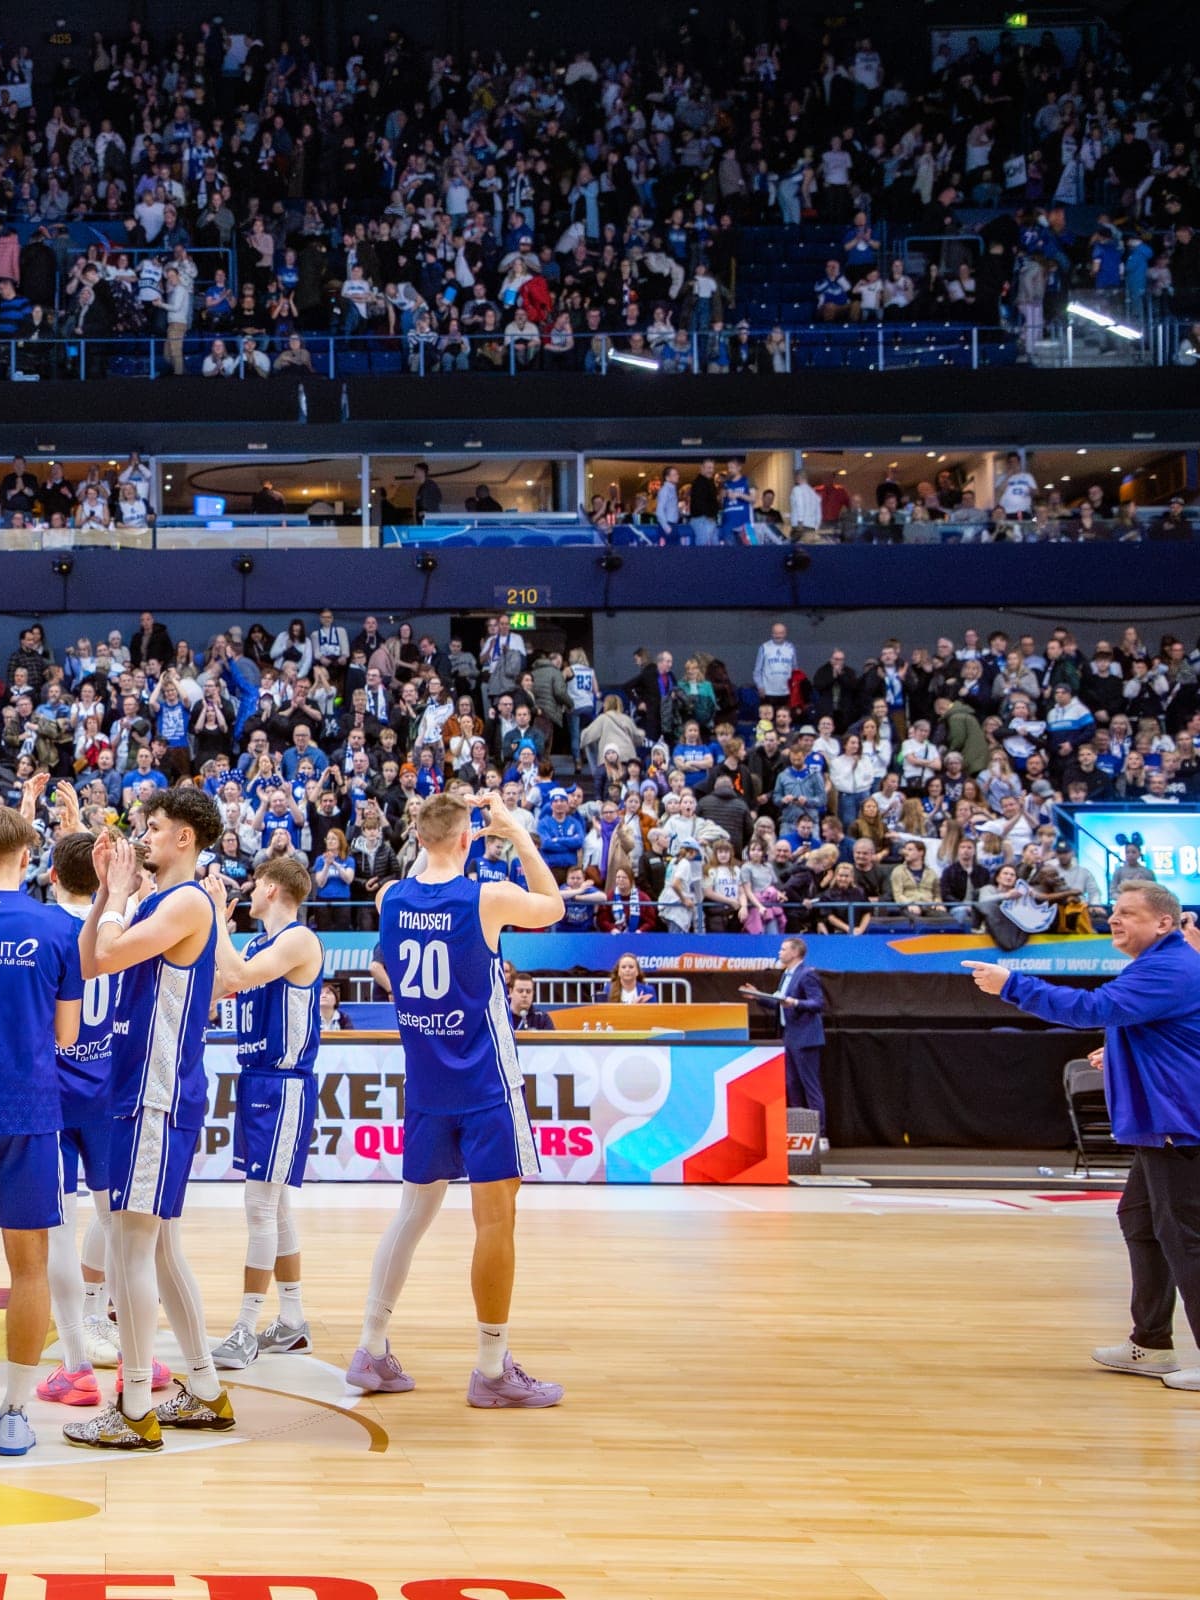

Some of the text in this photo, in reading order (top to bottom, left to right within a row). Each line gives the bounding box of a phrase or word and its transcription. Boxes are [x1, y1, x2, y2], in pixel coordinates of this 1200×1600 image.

[507, 588, 538, 604] 210
[399, 910, 452, 932] MADSEN
[3, 956, 15, 966] full
[15, 958, 36, 967] circle
[694, 957, 725, 969] WOLF
[727, 957, 777, 970] COUNTRY
[399, 939, 450, 1000] 20
[225, 1000, 232, 1008] 4
[226, 1010, 233, 1019] 3
[226, 1021, 233, 1029] 2
